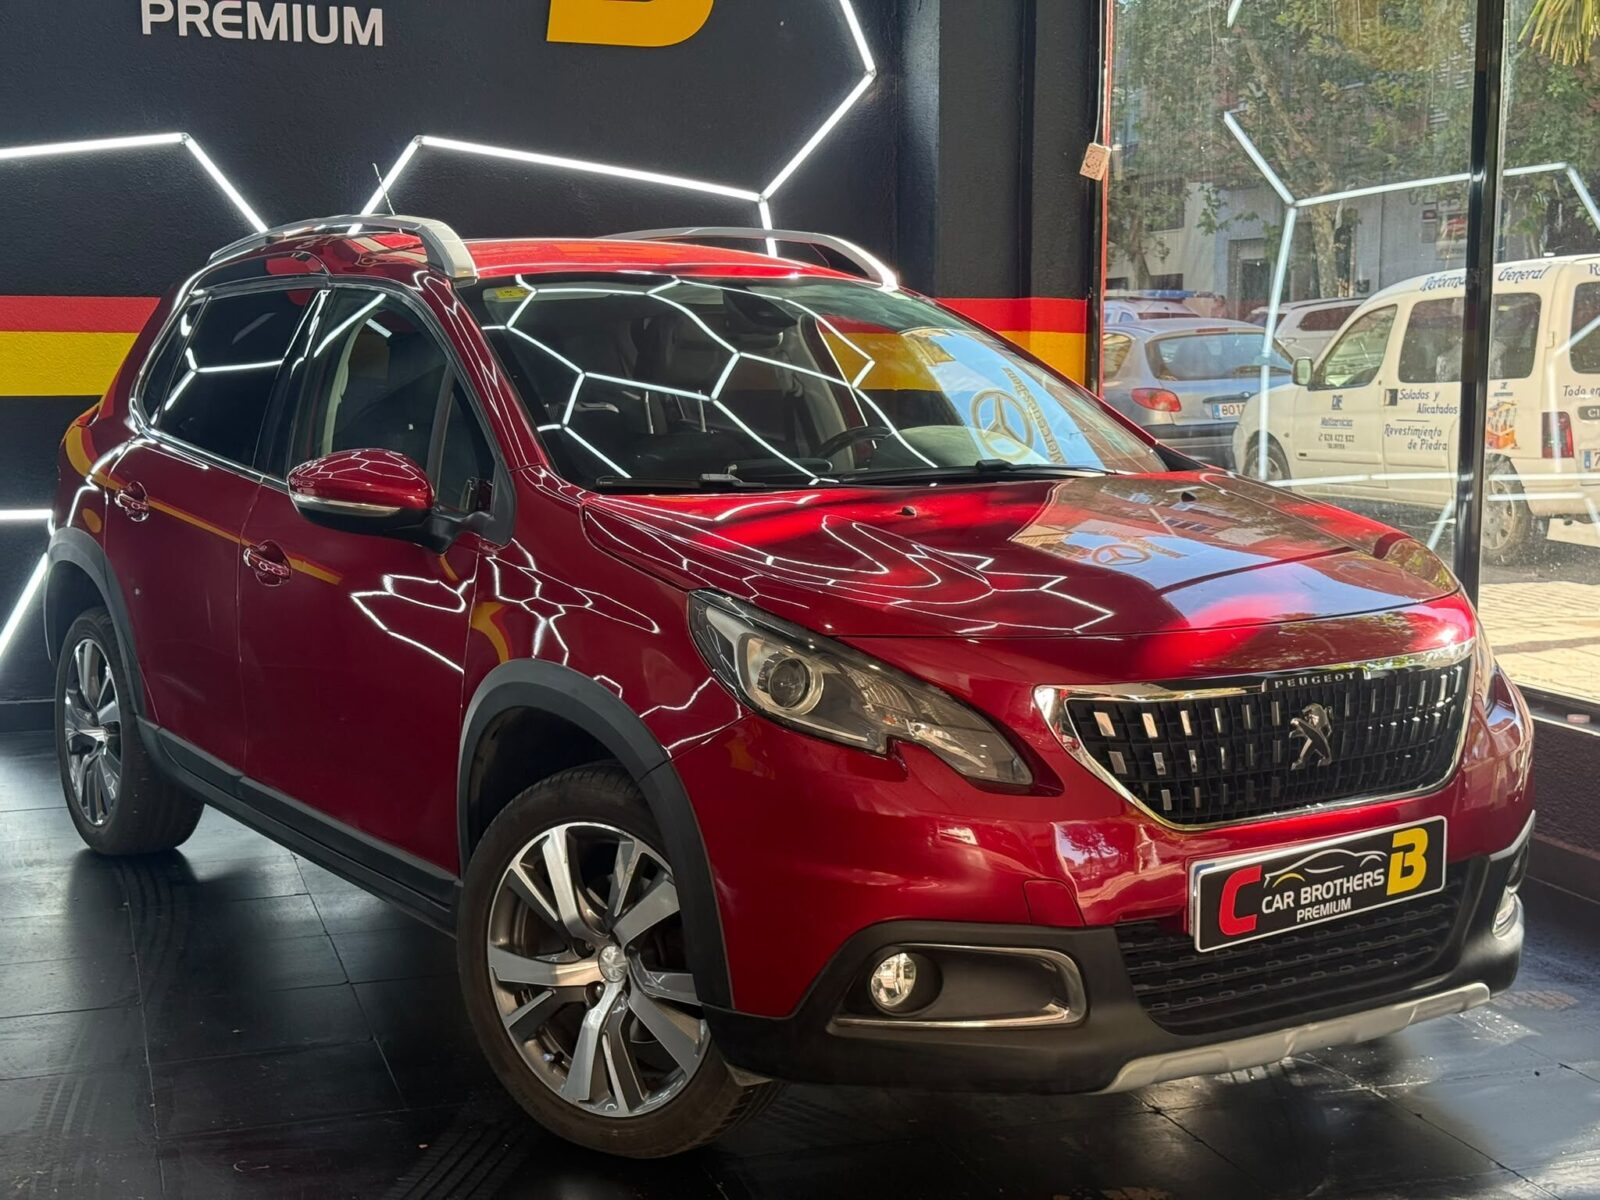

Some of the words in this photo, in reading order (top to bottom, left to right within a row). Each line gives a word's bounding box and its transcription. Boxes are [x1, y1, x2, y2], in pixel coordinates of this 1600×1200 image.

[140, 0, 384, 46] PREMIUM
[1497, 264, 1553, 284] General
[1399, 388, 1430, 401] Solados
[1433, 390, 1440, 402] y
[1417, 402, 1458, 415] Alicatados
[1384, 423, 1443, 439] Revestimiento
[1407, 439, 1417, 450] de
[1420, 438, 1448, 451] Piedra
[1274, 671, 1356, 689] PEUGEOT
[1261, 890, 1295, 915] CAR
[1300, 868, 1385, 906] BROTHERS
[1296, 897, 1352, 923] PREMIUM
